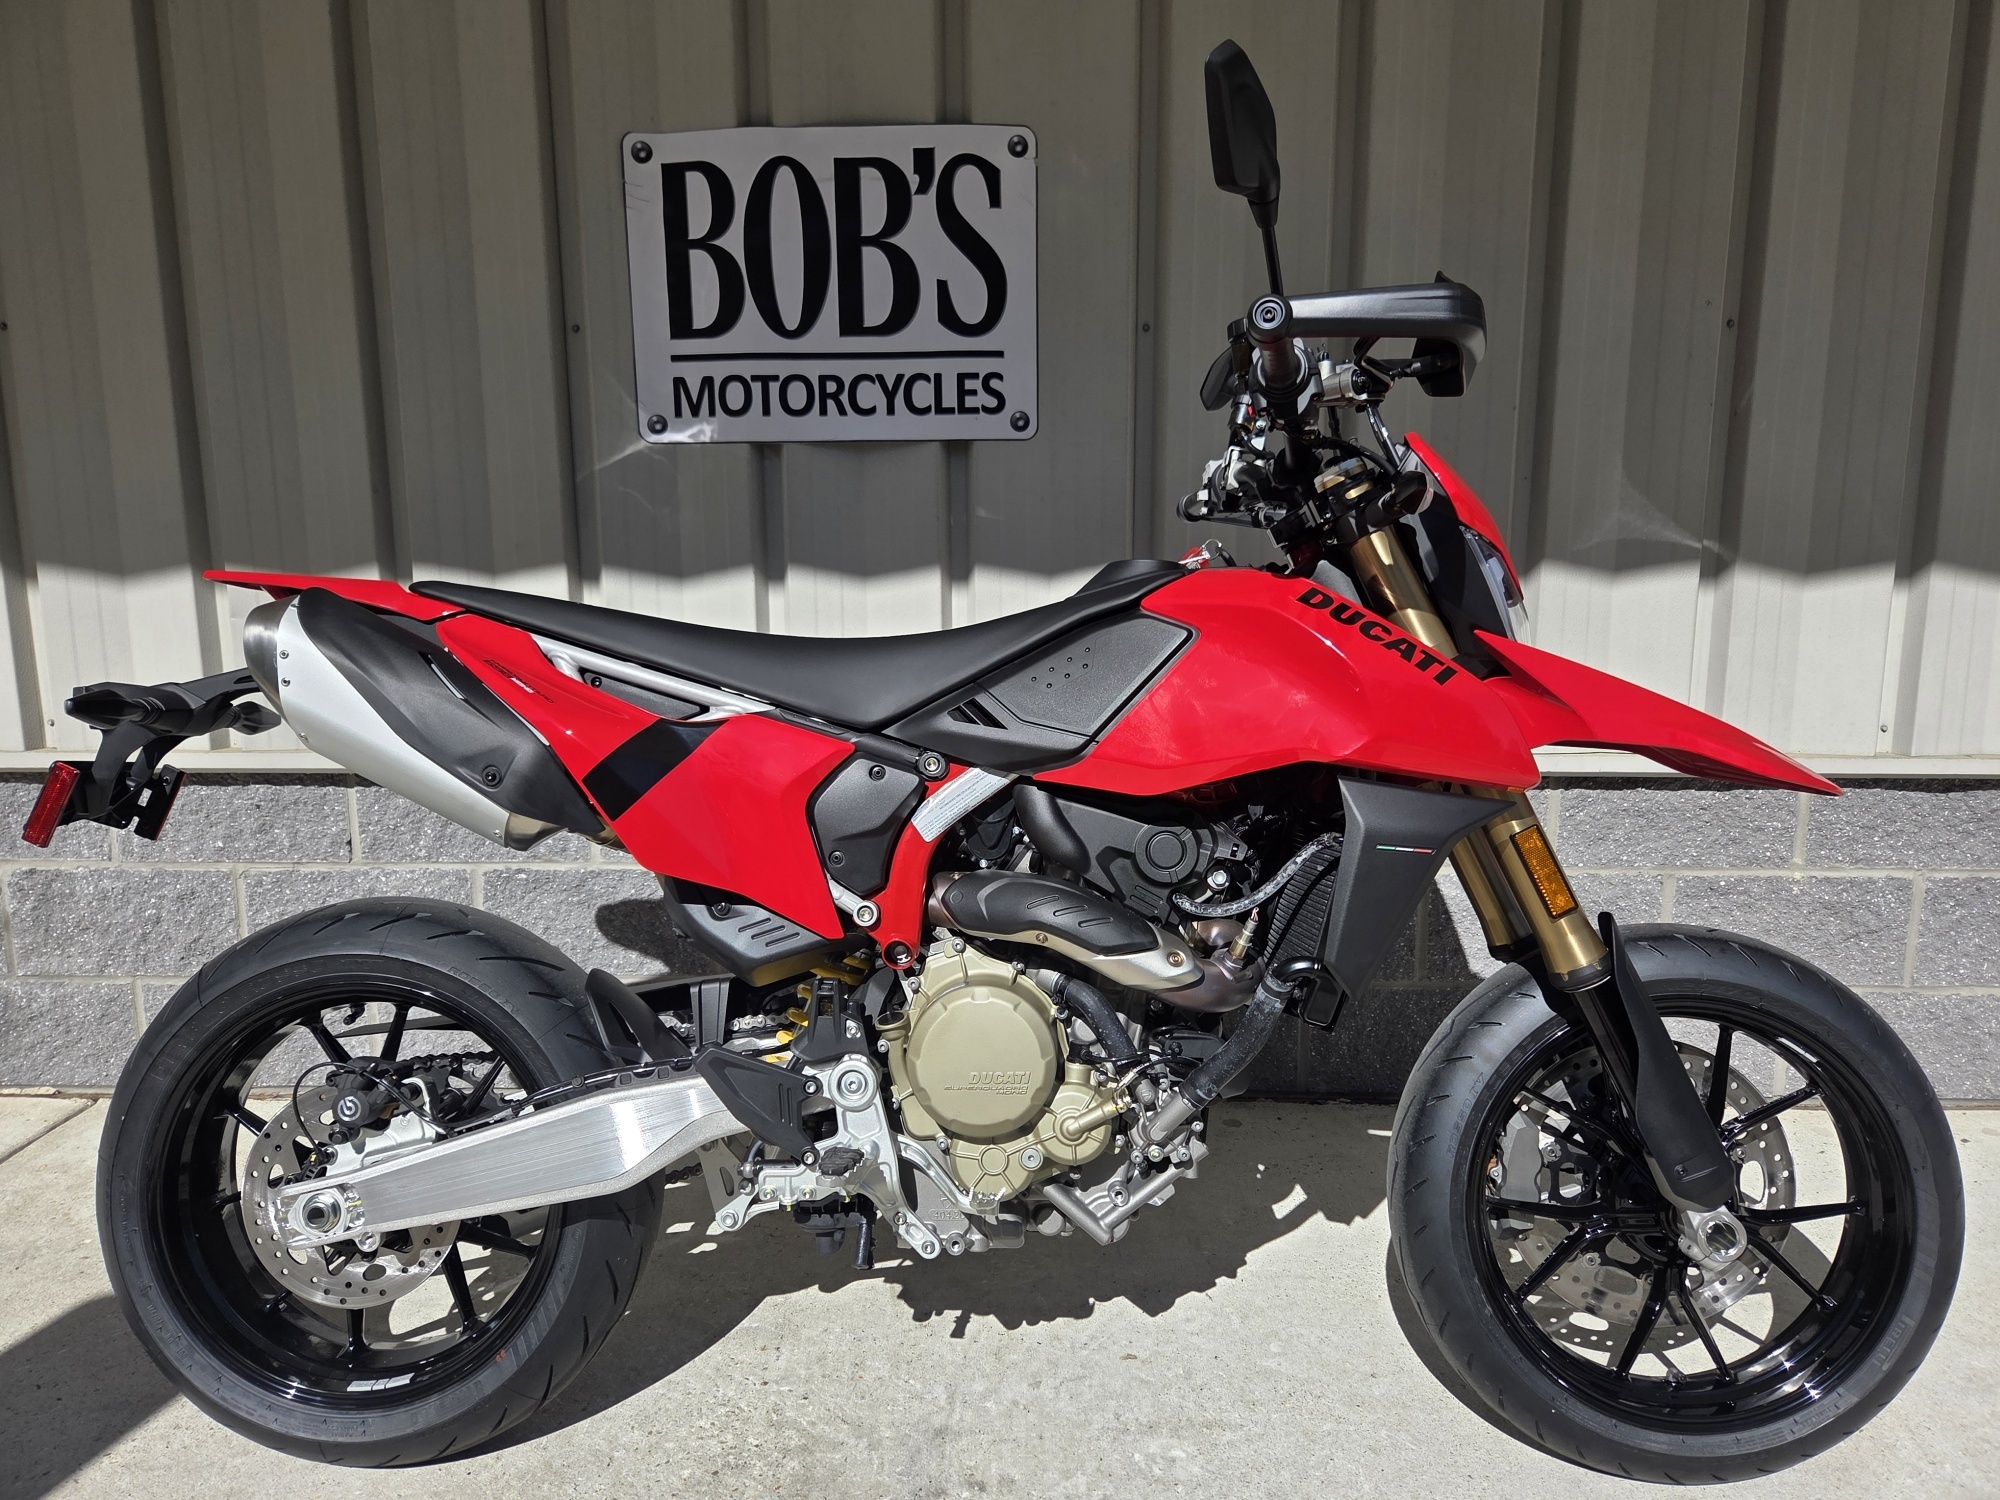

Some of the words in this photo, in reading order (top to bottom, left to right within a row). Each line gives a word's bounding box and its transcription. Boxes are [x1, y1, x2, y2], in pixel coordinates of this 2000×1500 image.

[660, 147, 1008, 340] BOB'S
[671, 372, 1007, 418] MOTORCYCLES
[1295, 587, 1458, 686] DUCATI
[968, 1071, 1032, 1085] DUCATI
[1872, 1314, 1917, 1371] PIRELLI
